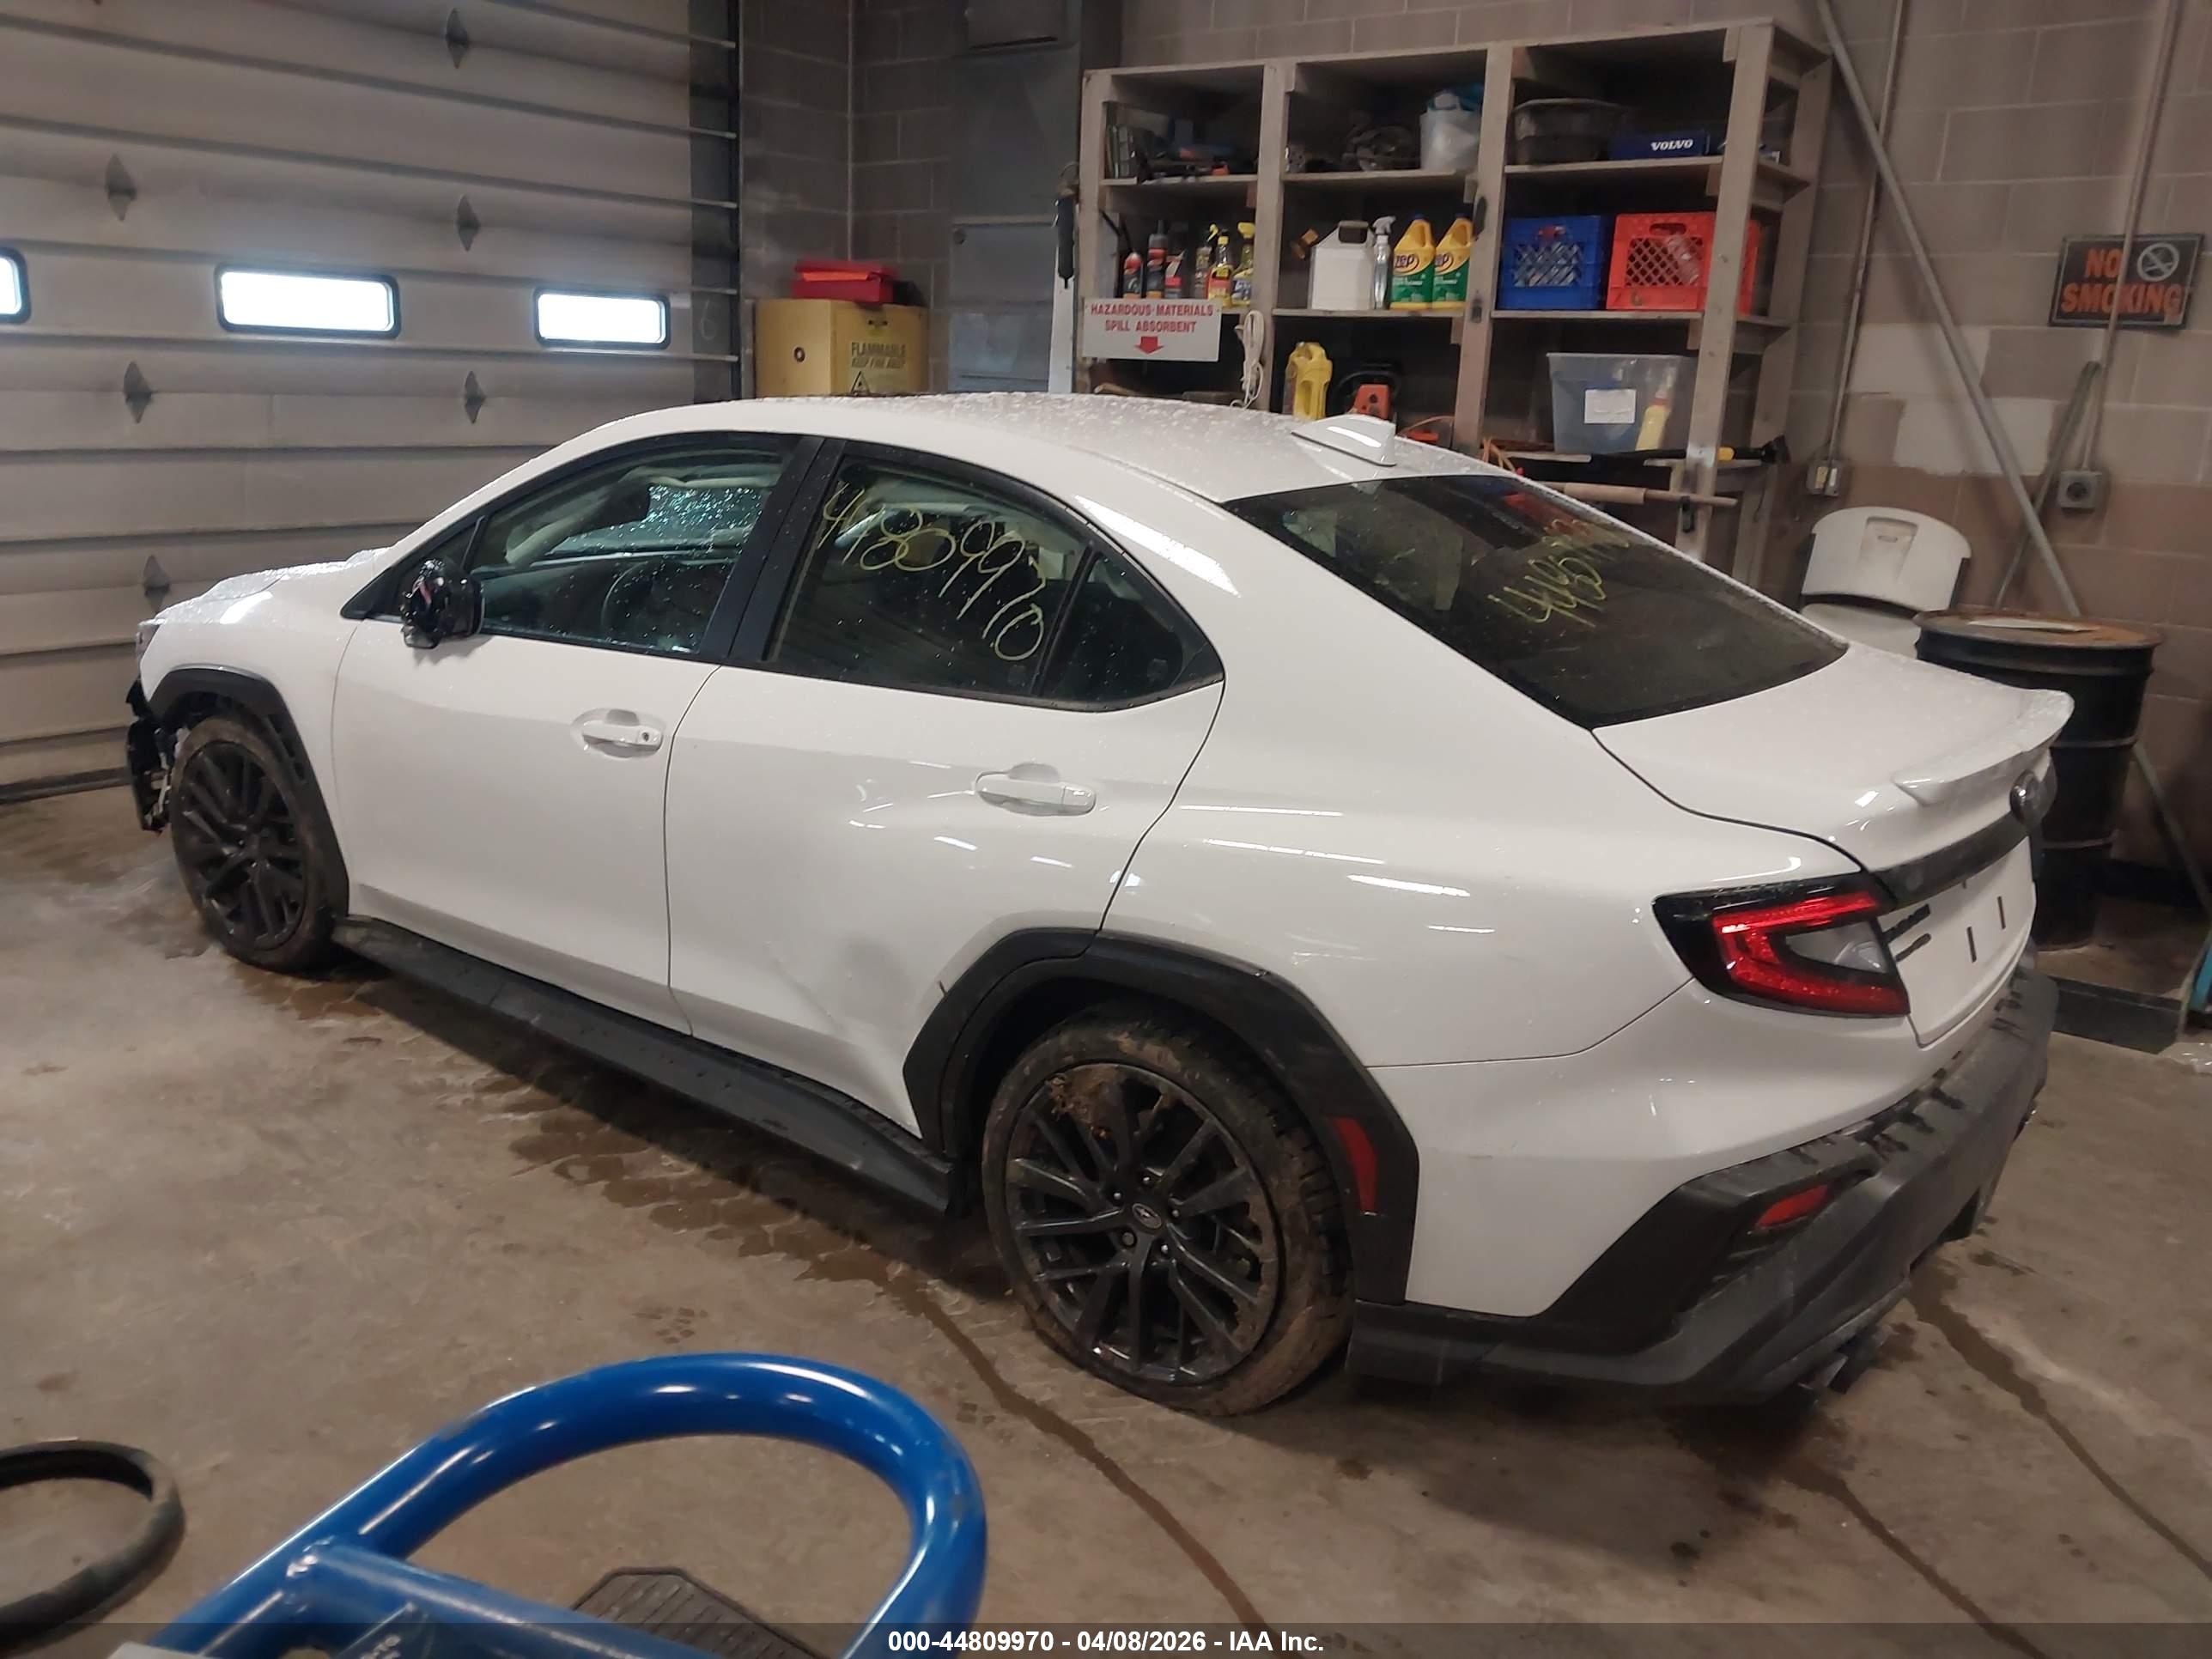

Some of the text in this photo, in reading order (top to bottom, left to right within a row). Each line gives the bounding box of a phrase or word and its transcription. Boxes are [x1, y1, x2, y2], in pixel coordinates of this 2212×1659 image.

[1650, 139, 1693, 151] VOLVO
[2084, 247, 2124, 277] NO
[2061, 282, 2183, 315] SMOKING
[1091, 303, 1213, 317] HAZARDOUS MATERIALS
[1105, 319, 1197, 333] SPILL ABSORBENT
[851, 342, 907, 357] FLAMMABLE
